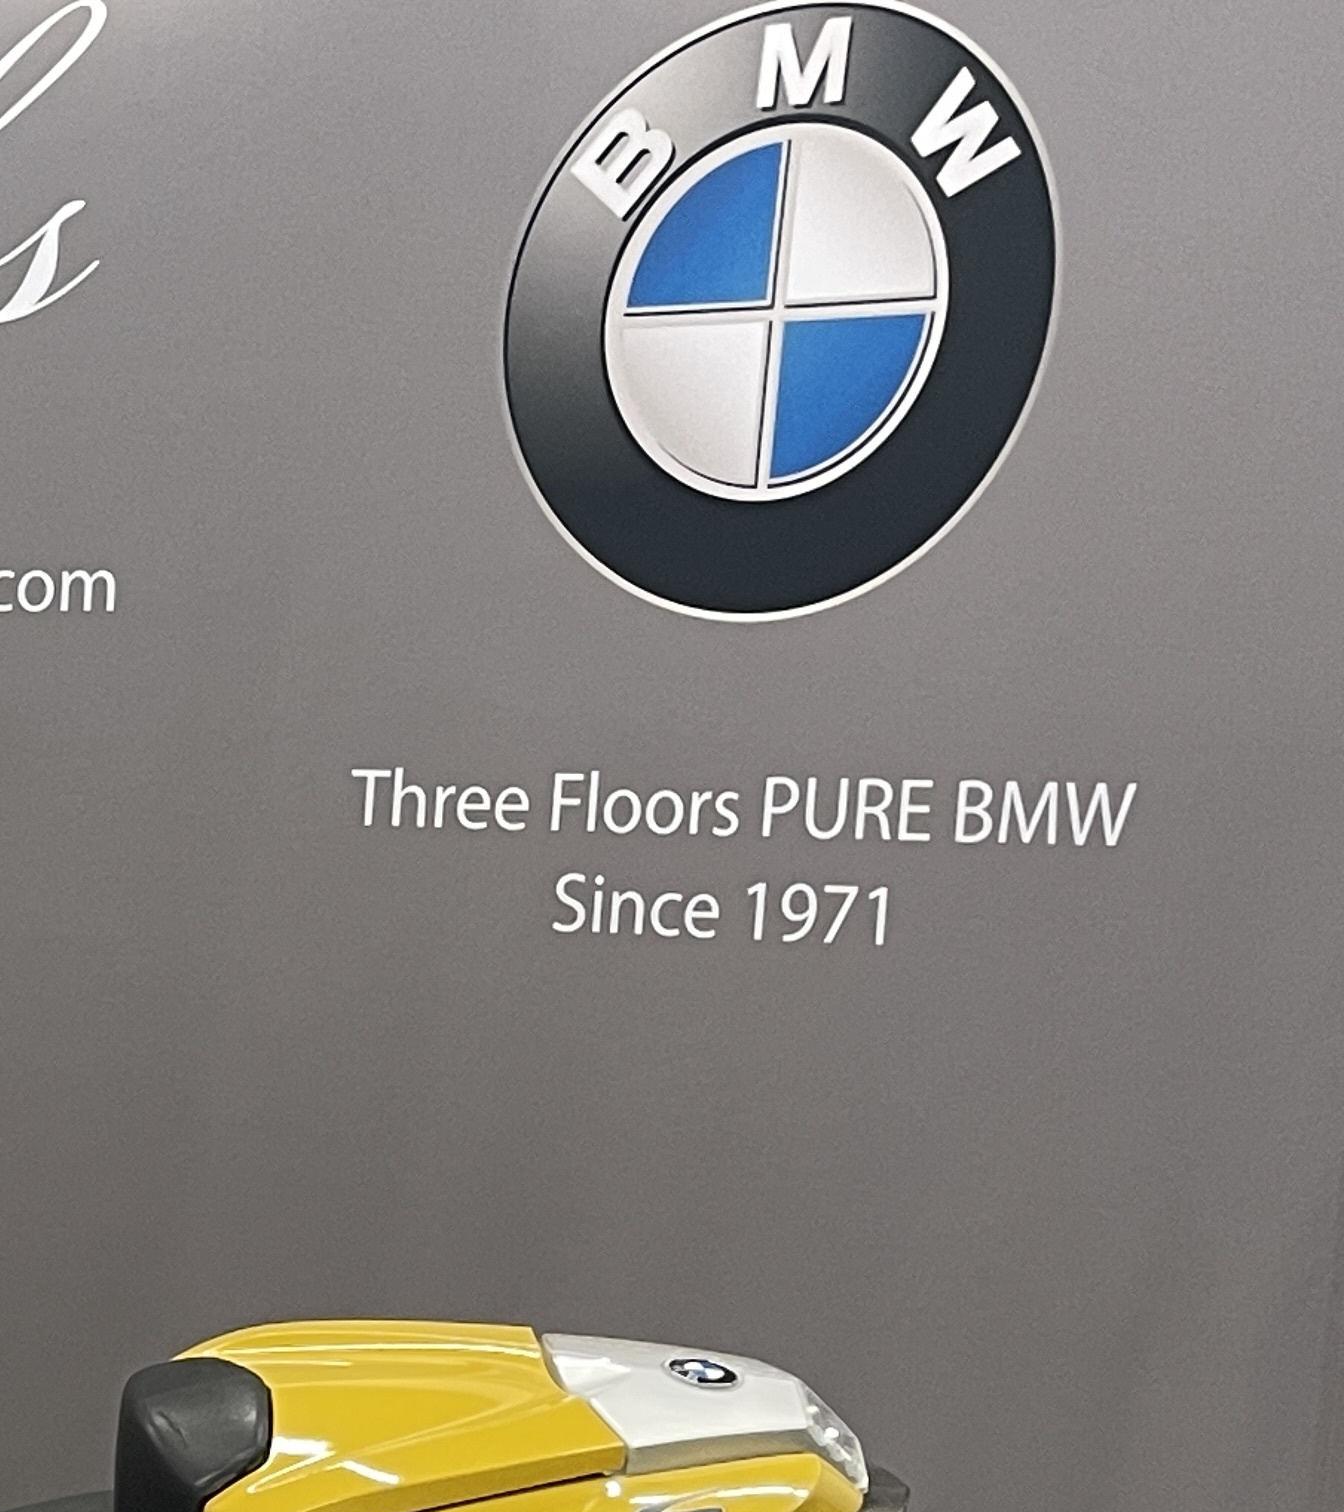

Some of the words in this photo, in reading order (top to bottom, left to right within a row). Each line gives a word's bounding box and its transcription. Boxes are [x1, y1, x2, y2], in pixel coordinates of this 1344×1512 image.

[570, 16, 1021, 220] BMW
[351, 767, 530, 831] Three
[550, 770, 739, 837] Floors
[762, 776, 934, 842] PURE
[954, 779, 1138, 846] BMW
[552, 872, 720, 938] Since
[746, 882, 889, 946] 1971
